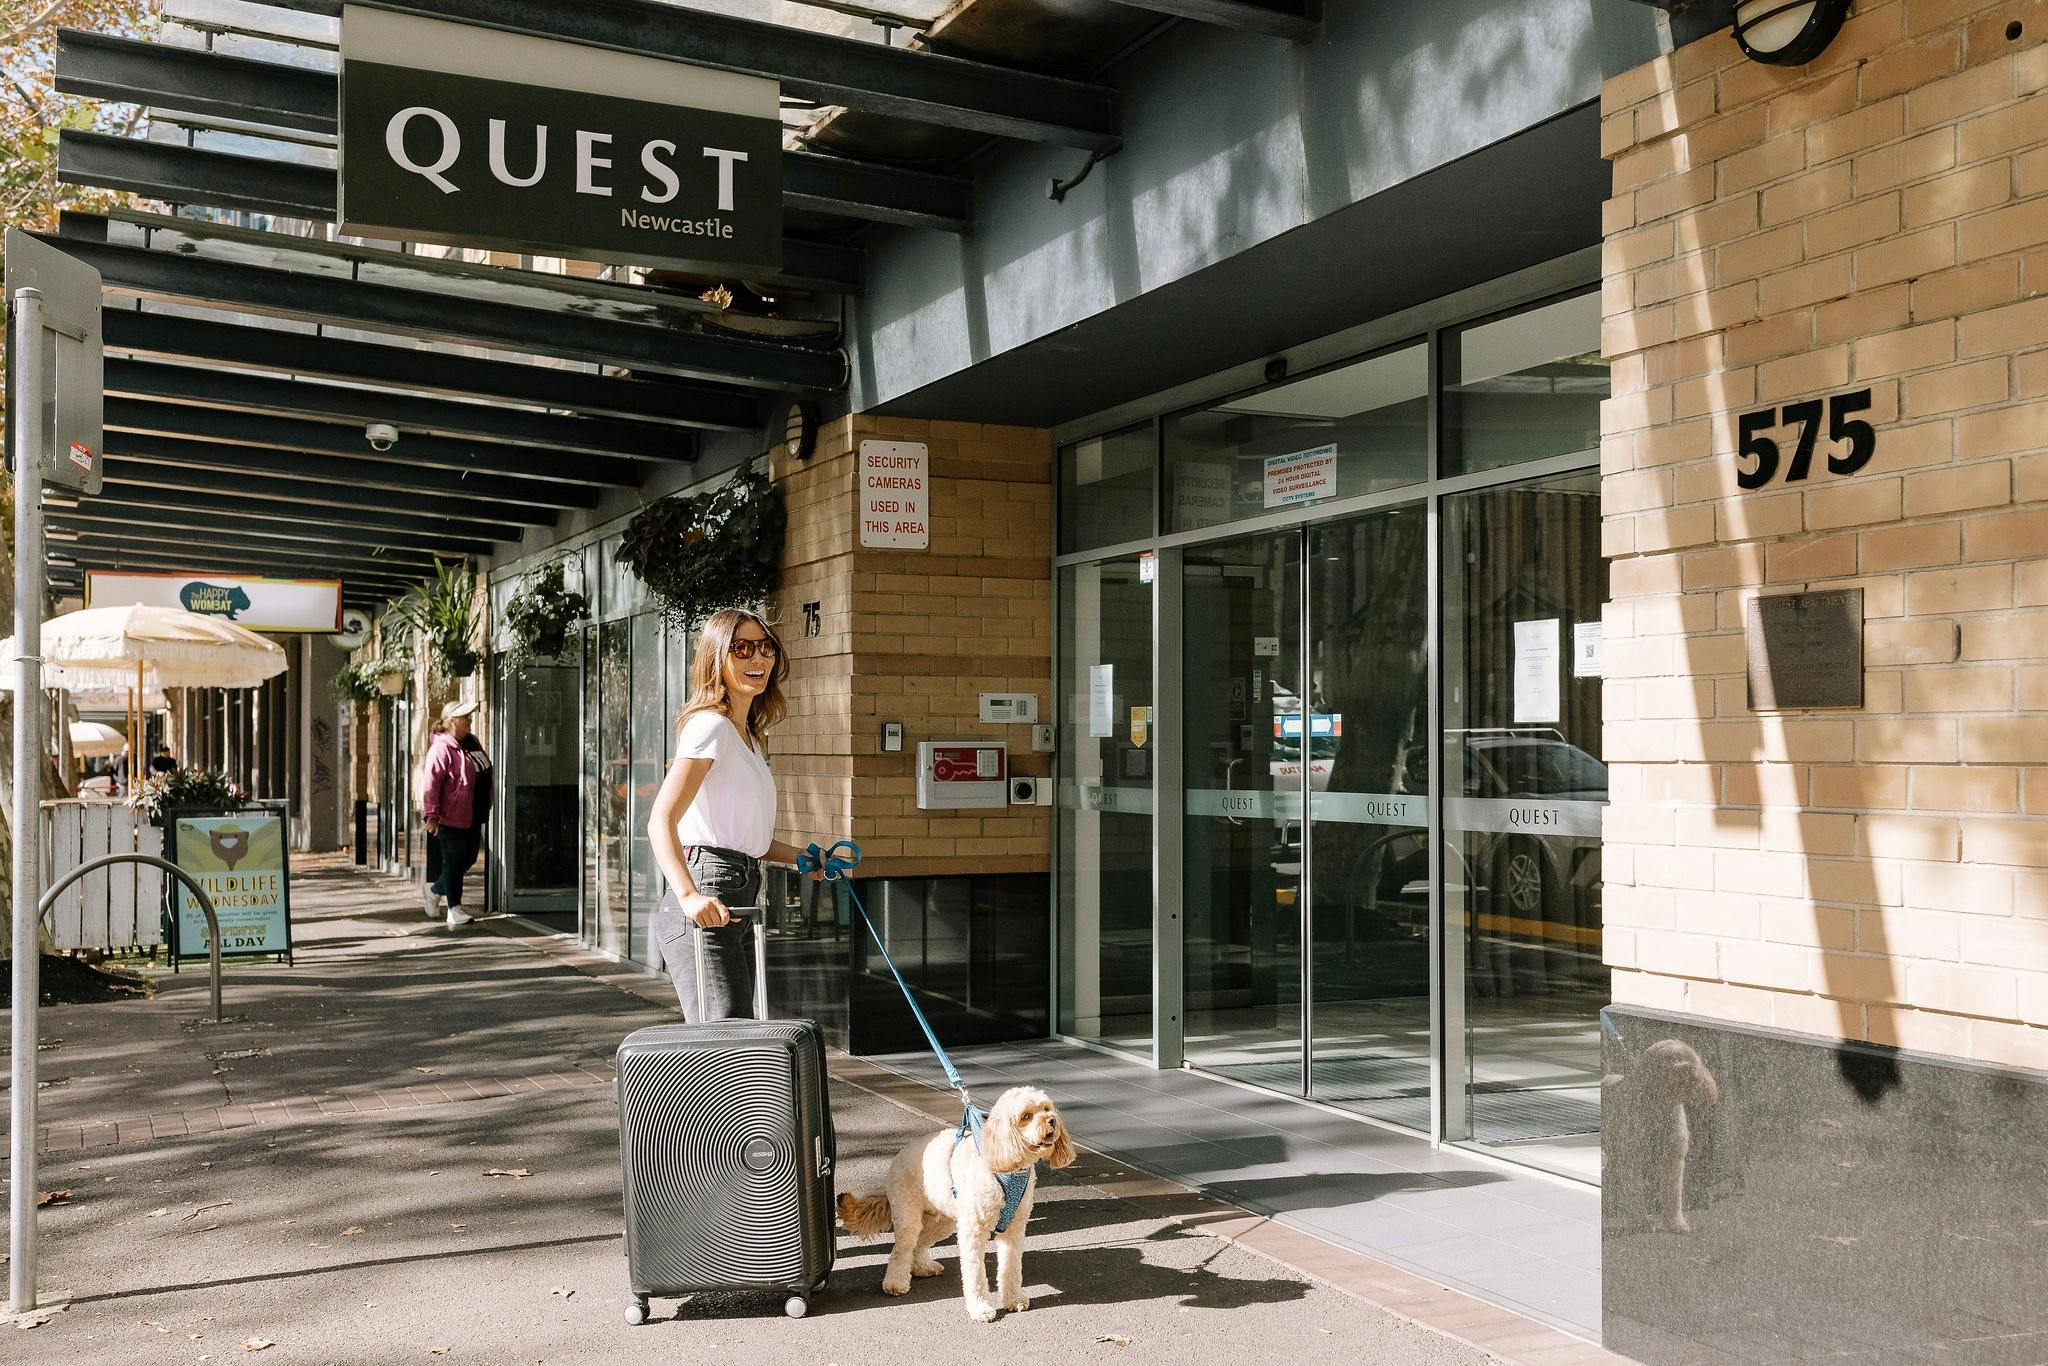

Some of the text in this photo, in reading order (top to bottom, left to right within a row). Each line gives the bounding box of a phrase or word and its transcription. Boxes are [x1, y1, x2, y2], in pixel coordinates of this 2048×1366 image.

[385, 106, 749, 211] QUEST
[621, 208, 734, 239] Newcastle
[1737, 387, 1876, 490] 575
[867, 456, 920, 469] SECURITY
[1267, 446, 1333, 467] DIGITAL VIDEO RECORDING
[1267, 458, 1333, 478] PREMISES PROTECTED BY
[867, 476, 921, 490] CAMERAS
[1285, 474, 1300, 484] HOUR
[1300, 470, 1321, 480] DIGITAL
[1272, 478, 1327, 495] VIDEO SURVEILLANCE
[870, 500, 916, 513] USED IN
[865, 521, 925, 534] THIS AREA
[200, 587, 230, 600] HAPPY
[803, 601, 821, 637] 75
[1222, 797, 1254, 811] QUEST
[1367, 801, 1407, 818] QUEST
[1509, 808, 1560, 827] QUEST
[186, 894, 279, 909] WDNESDAY
[203, 936, 266, 949] AL DAY
